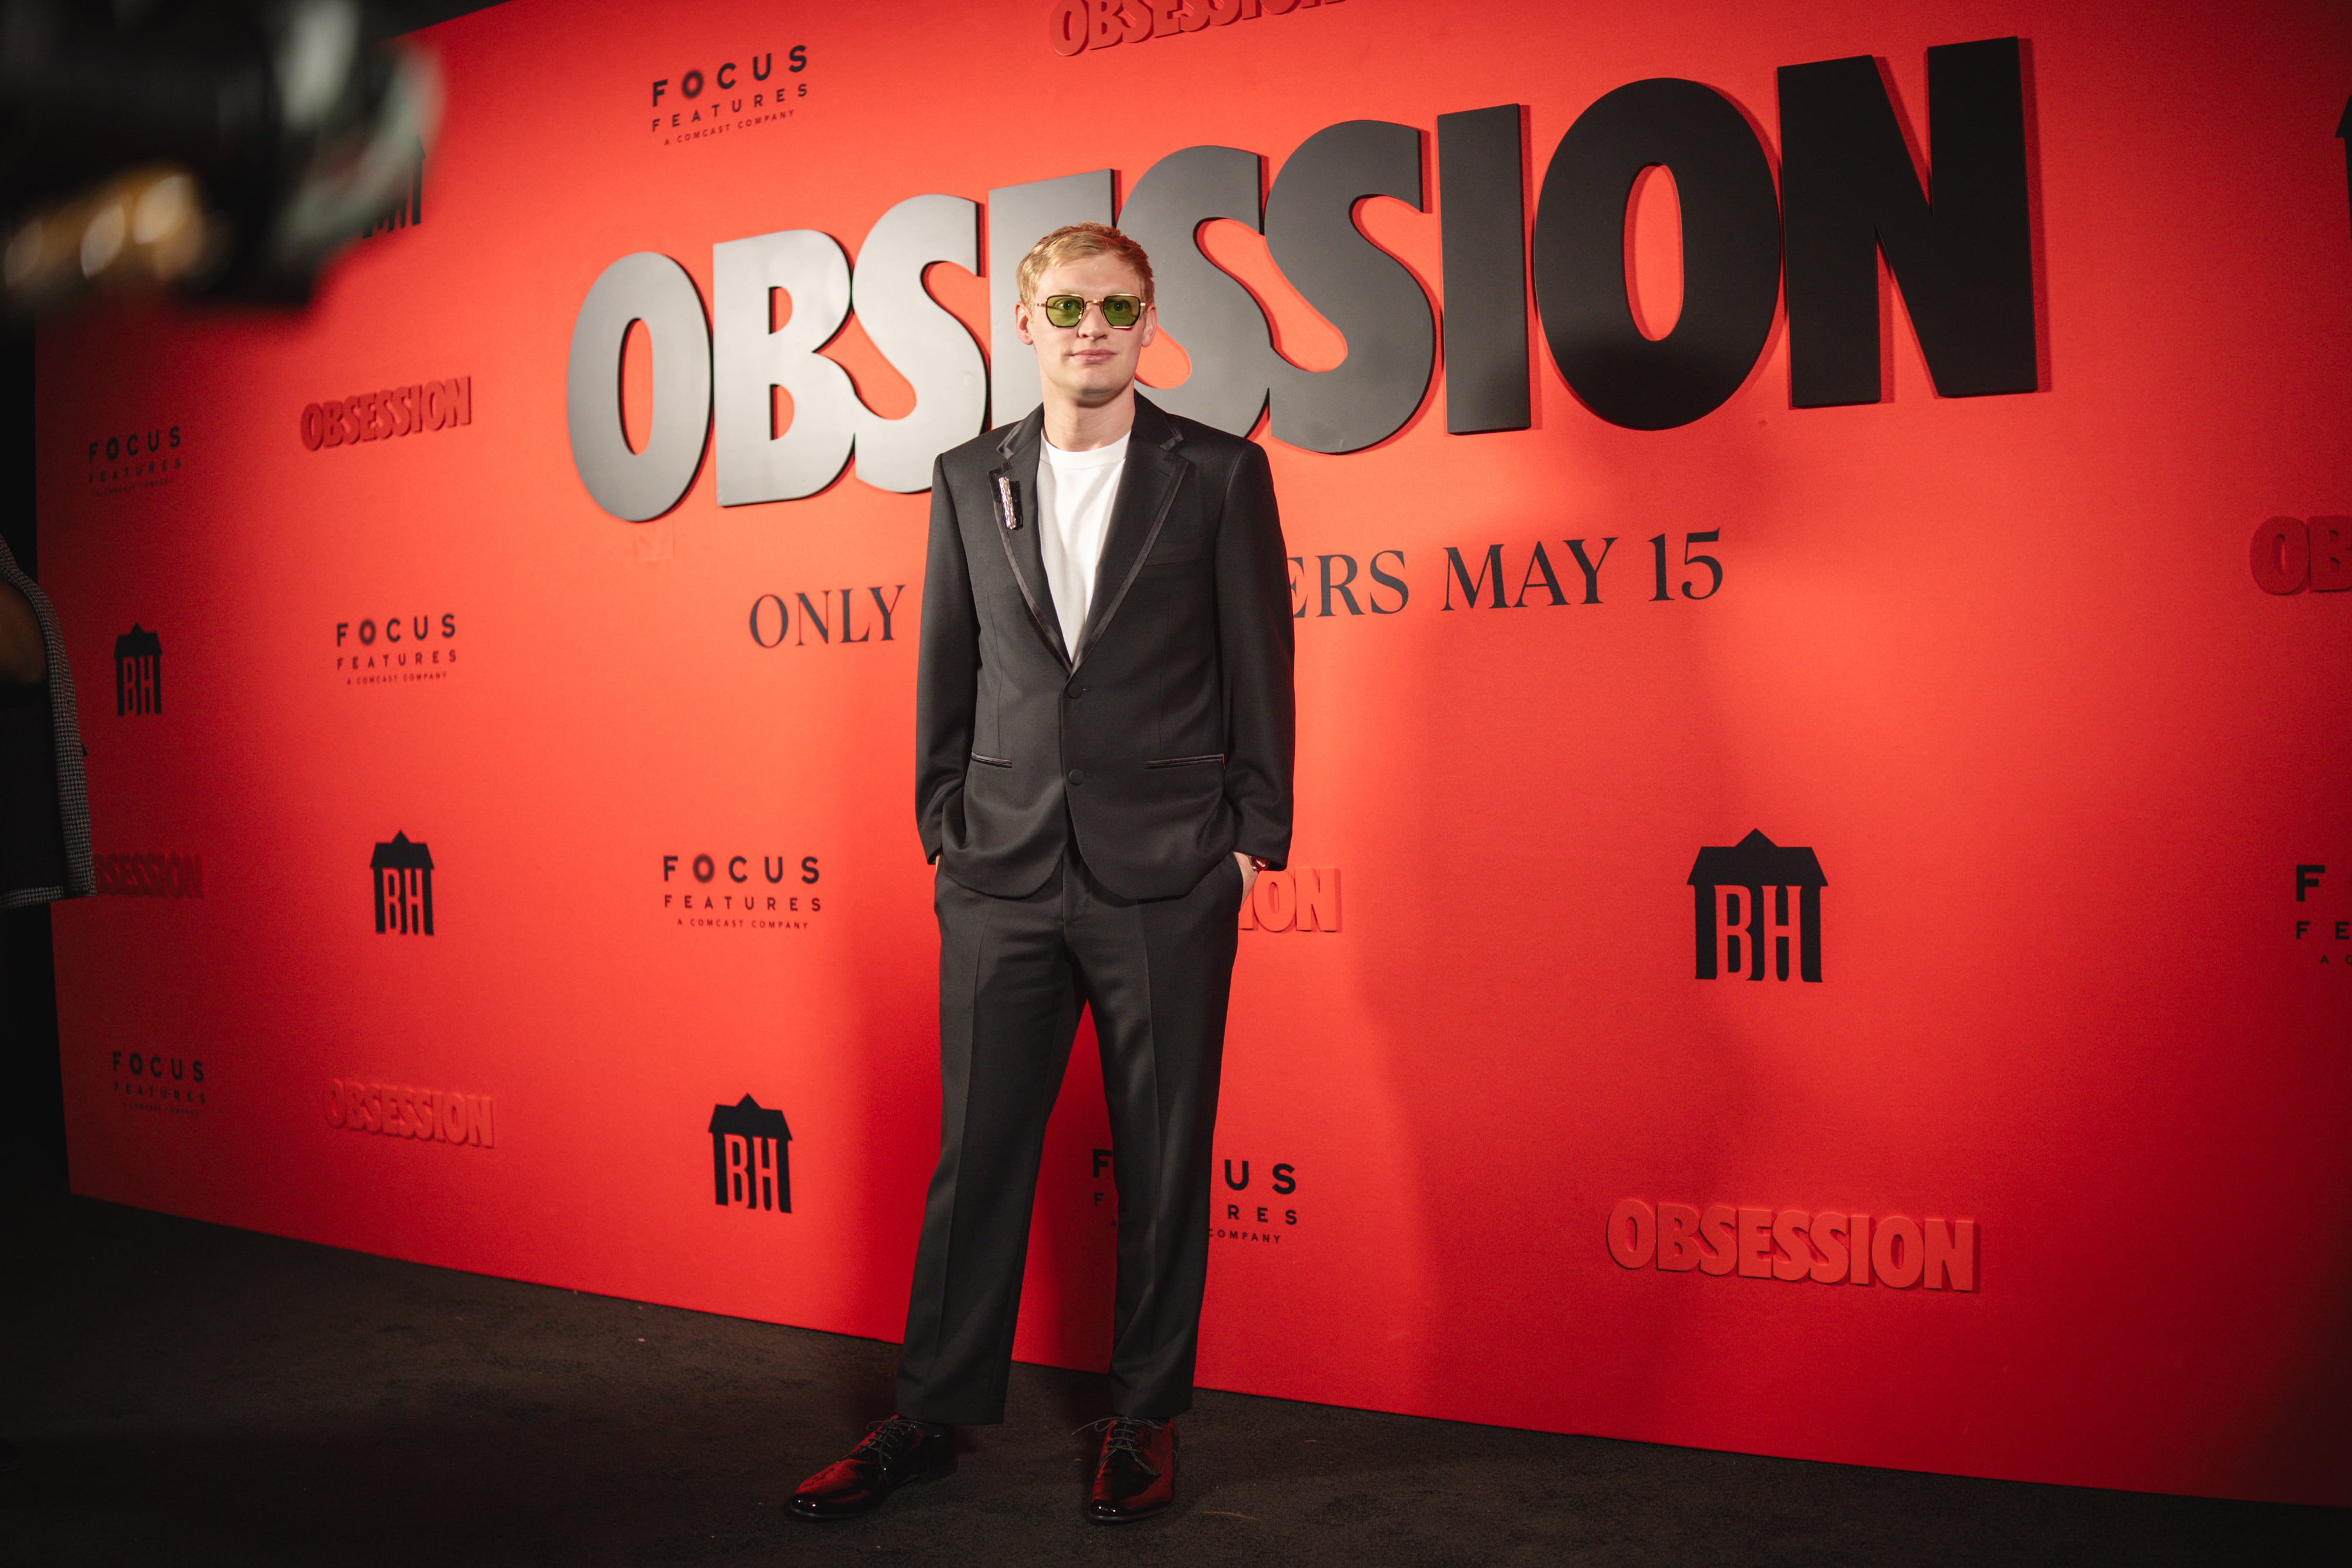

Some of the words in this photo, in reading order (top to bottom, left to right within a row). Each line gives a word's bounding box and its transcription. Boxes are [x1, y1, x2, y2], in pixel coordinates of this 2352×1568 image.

[652, 45, 807, 107] FOCUS
[652, 83, 807, 132] FEATURES
[664, 138, 670, 146] A
[677, 124, 730, 143] COMCAST
[737, 109, 795, 129] COMPANY
[567, 35, 2039, 523] OBSESSION
[300, 375, 471, 452] OBSESSION
[89, 425, 181, 464] FOCUS
[1441, 536, 1619, 611] MAY
[1648, 527, 1723, 601] 15
[336, 613, 456, 647] FOCUS
[749, 584, 906, 648] ONLY
[337, 649, 456, 670] FEATURES
[356, 674, 397, 685] COMCAST
[403, 672, 447, 682] COMPANY
[663, 853, 820, 884] FOCUS
[382, 867, 425, 934] BH
[664, 895, 821, 911] FEATURES
[690, 918, 743, 927] COMCAST
[751, 921, 808, 929] COMPANY
[1713, 884, 1803, 981] BH
[112, 1049, 204, 1083] FOCUS
[325, 1077, 495, 1149] OBSESSION
[724, 1133, 781, 1212] BH
[1606, 1198, 1975, 1292] OBSESSION
